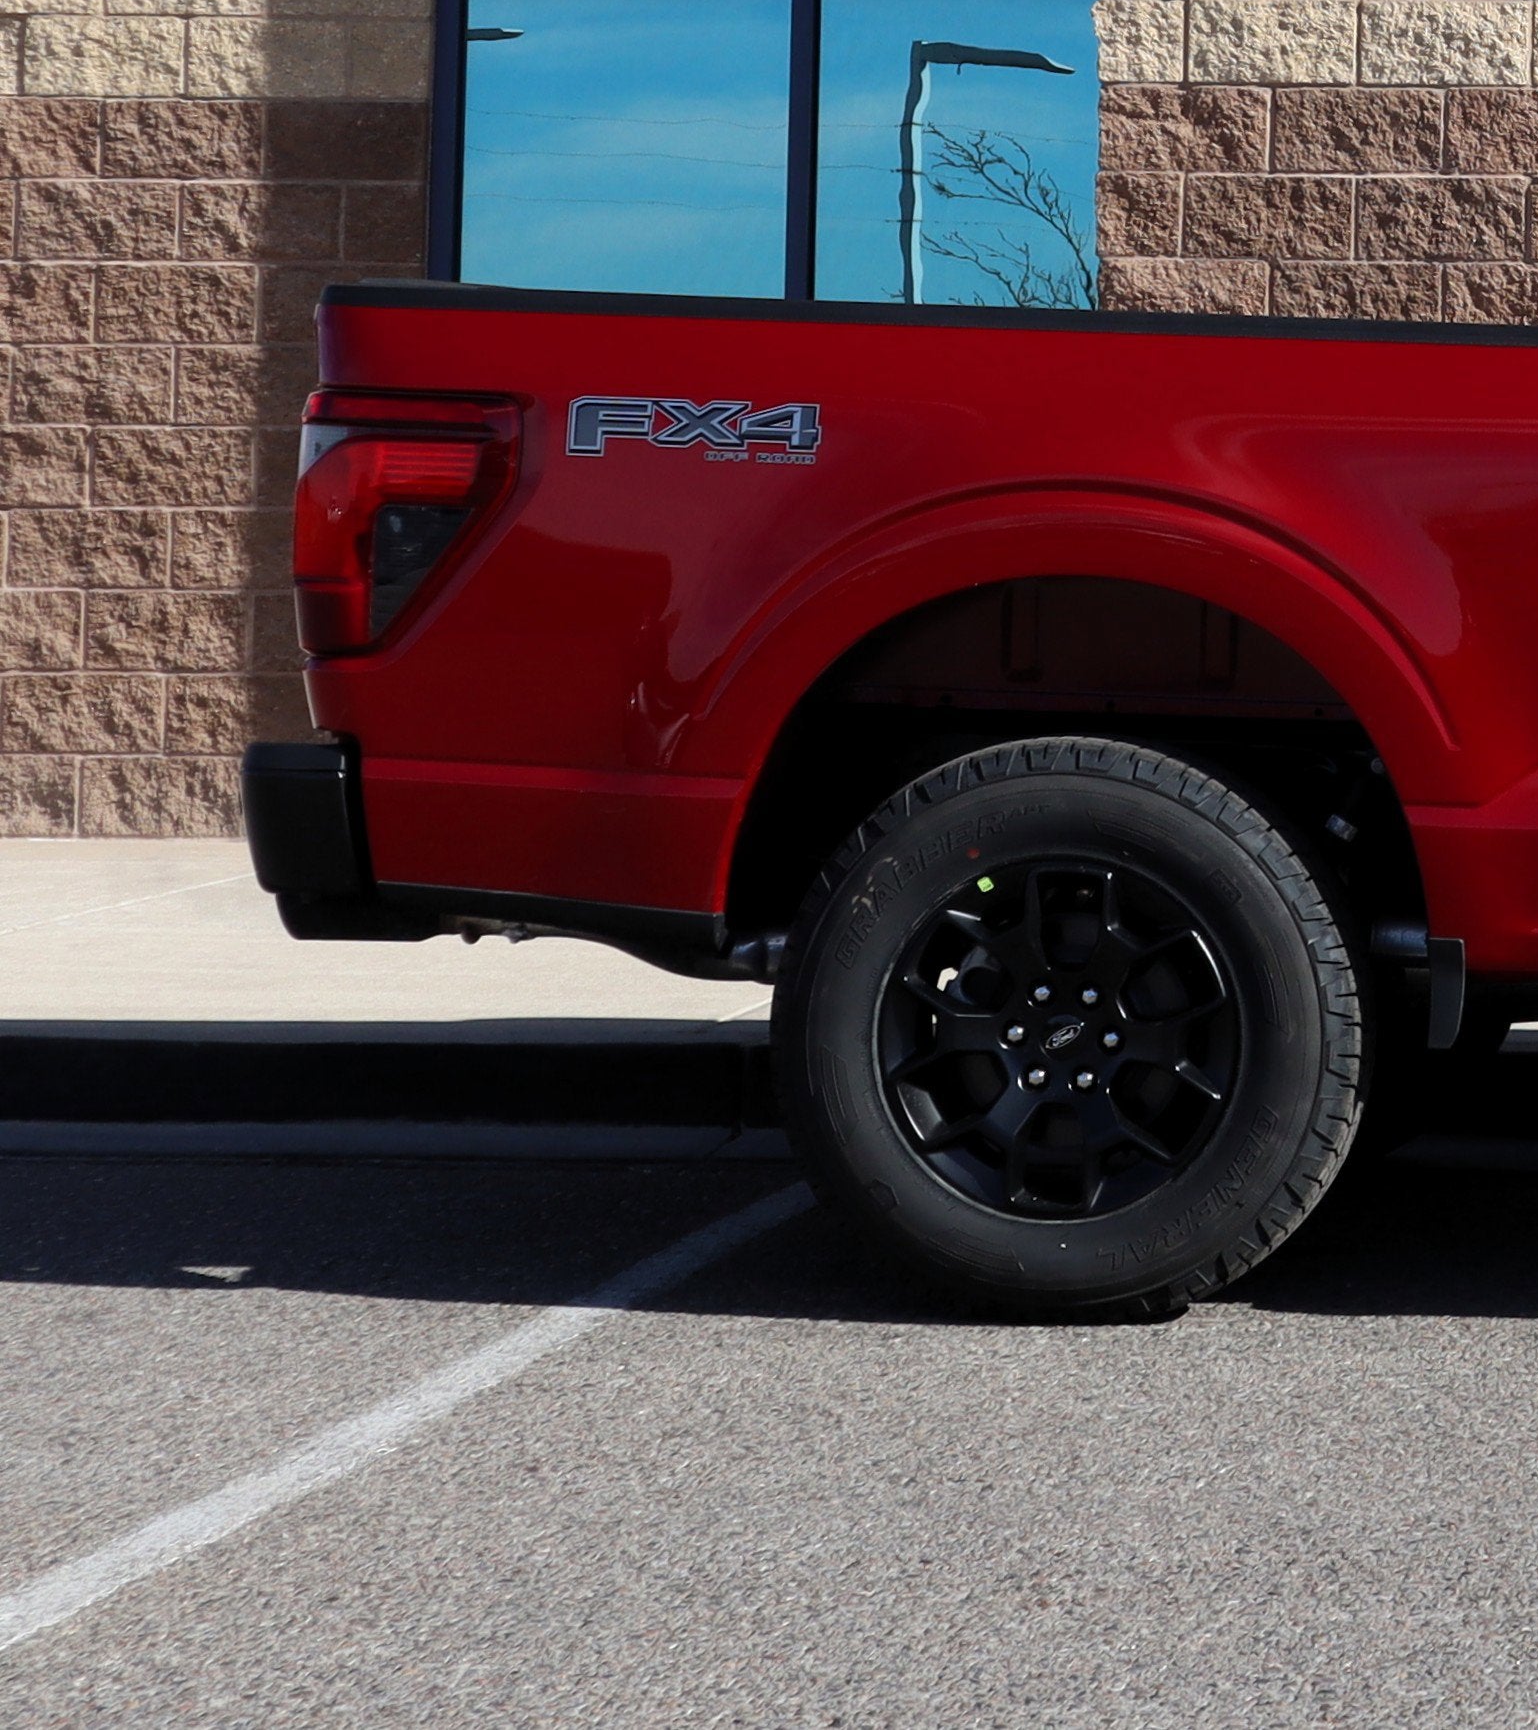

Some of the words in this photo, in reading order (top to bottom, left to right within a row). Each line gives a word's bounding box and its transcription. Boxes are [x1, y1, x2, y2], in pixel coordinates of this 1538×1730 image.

[566, 396, 822, 456] FX4
[704, 451, 749, 462] OFF
[756, 452, 816, 464] ROAD
